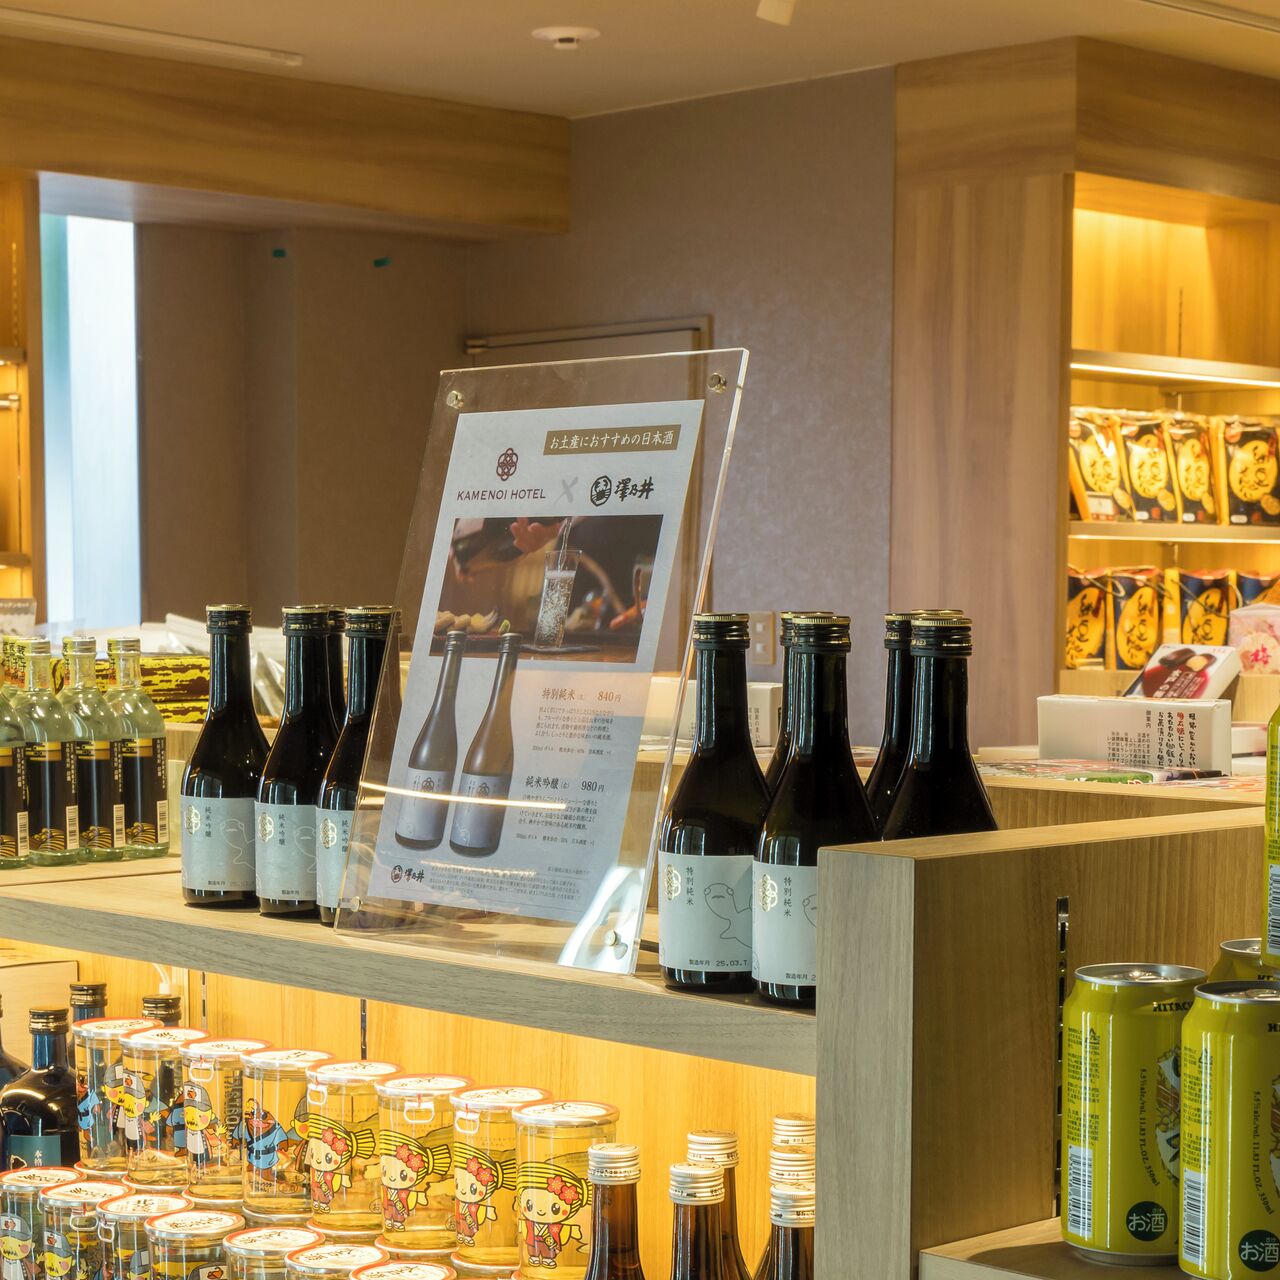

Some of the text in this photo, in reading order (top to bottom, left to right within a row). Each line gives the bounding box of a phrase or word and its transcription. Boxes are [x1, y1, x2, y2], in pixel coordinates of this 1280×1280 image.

[550, 430, 674, 449] お土産におすすめの日本酒
[457, 488, 546, 500] KAMENOI HOTEL
[542, 688, 575, 700] 特別純米
[526, 775, 605, 792] 純米吟醸 980円
[686, 866, 694, 906] 特別純米
[783, 877, 792, 917] 特別純米
[1128, 1208, 1165, 1232] お酒
[1240, 1238, 1279, 1262] お酒
